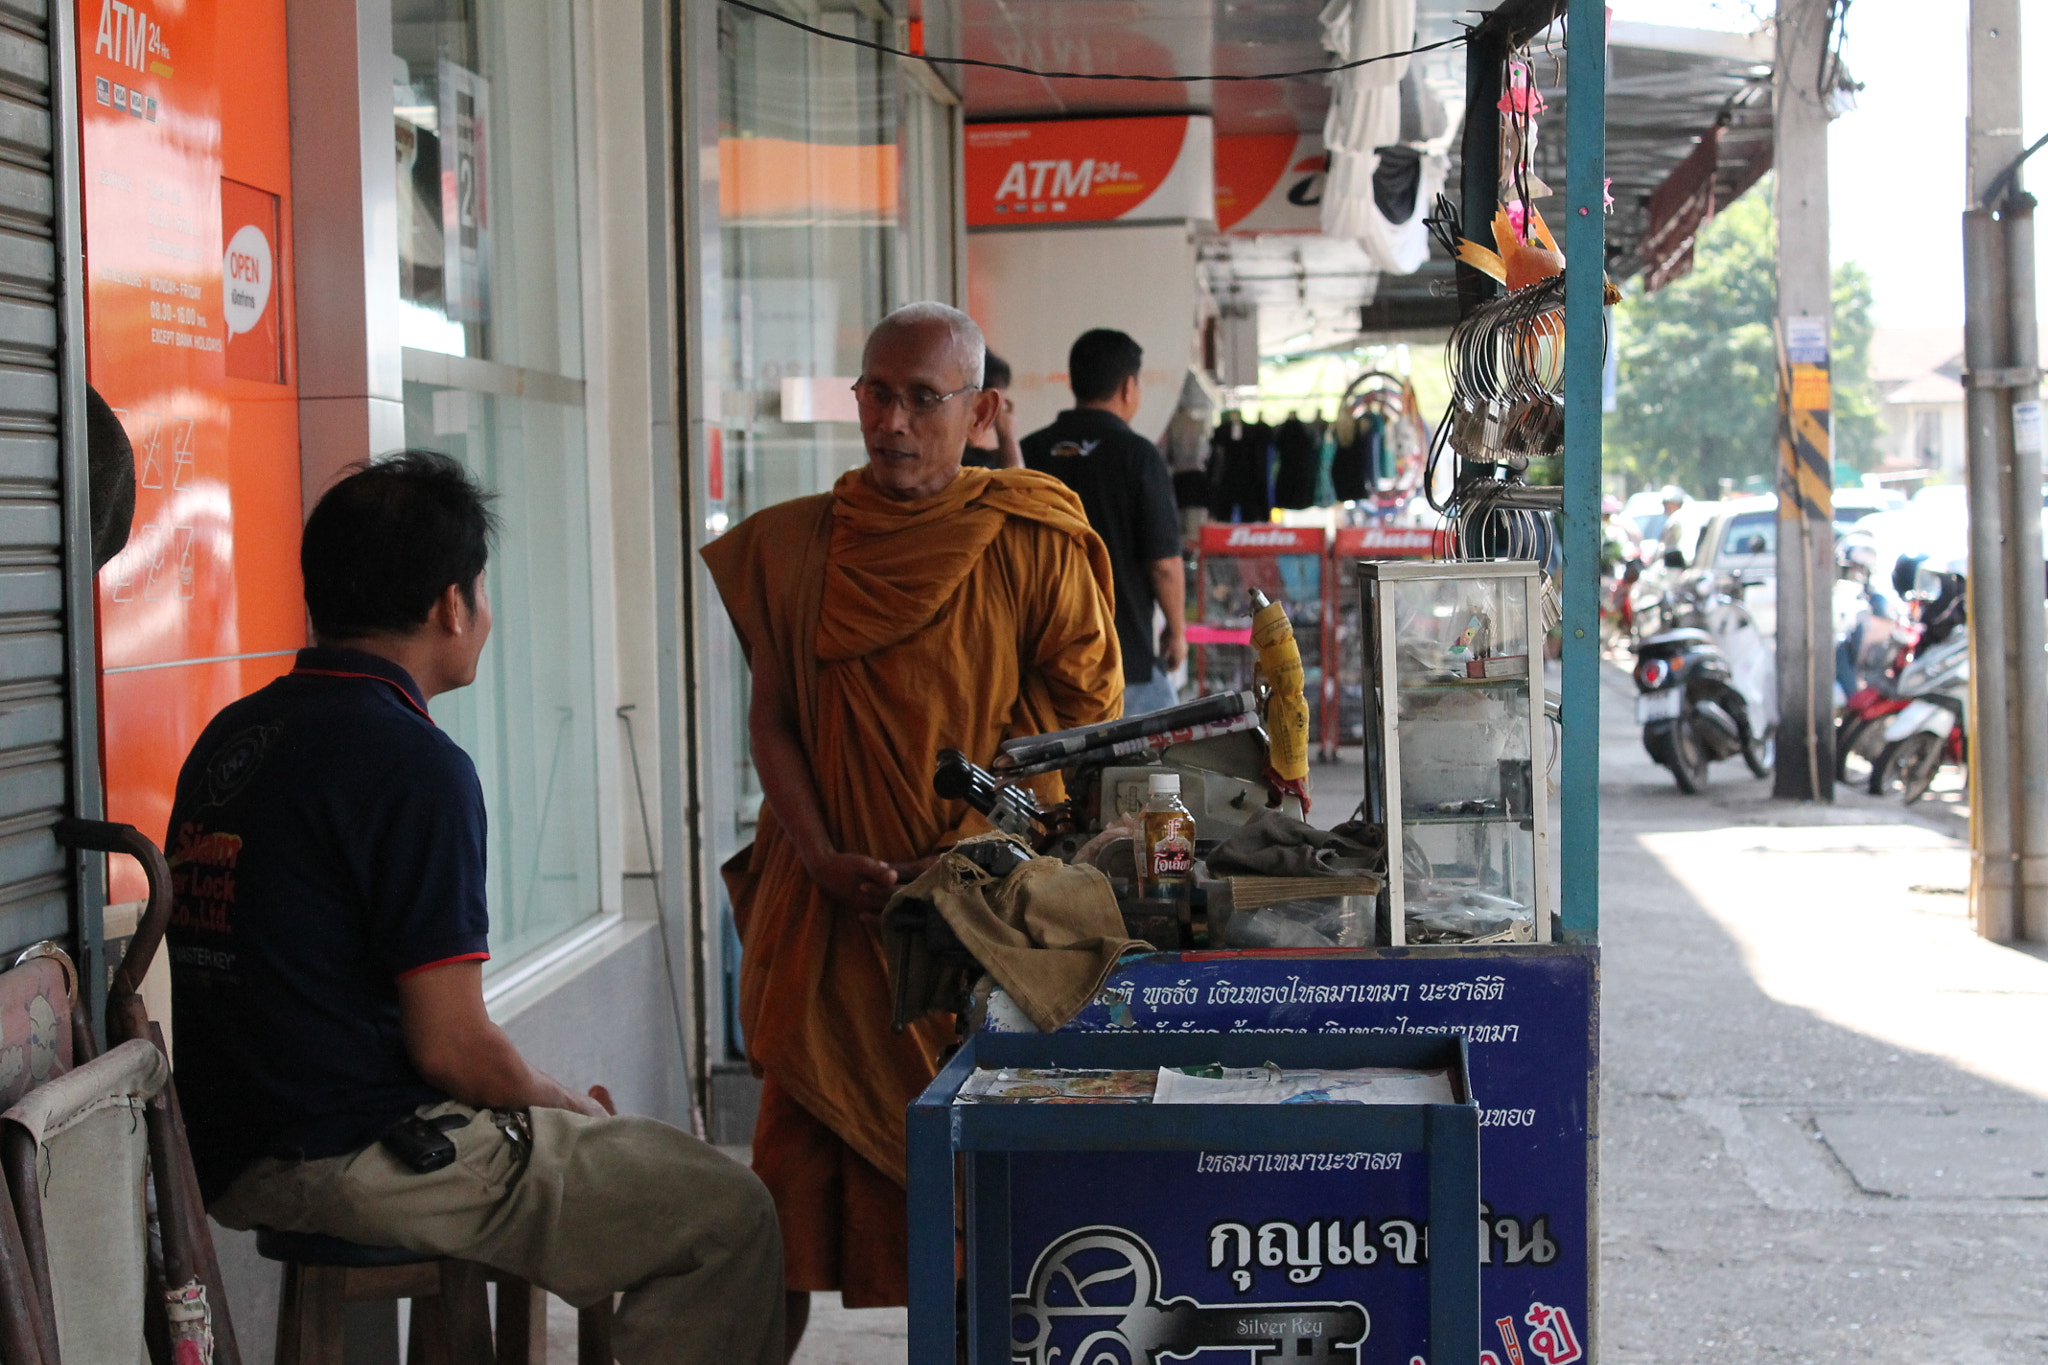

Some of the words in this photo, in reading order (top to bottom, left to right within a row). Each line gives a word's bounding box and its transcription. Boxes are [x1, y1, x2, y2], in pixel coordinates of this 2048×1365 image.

[95, 0, 147, 72] ATM
[148, 22, 161, 55] 24
[994, 158, 1096, 200] ATM
[1095, 161, 1121, 183] 24
[231, 252, 259, 284] OPEN
[177, 821, 240, 868] Siam
[191, 866, 237, 903] Lock
[1206, 975, 1410, 1005] เงินทองไหลมาเทมา
[1419, 975, 1506, 1001] นะชาลีติ
[1236, 1317, 1287, 1337] Silver
[1291, 1317, 1323, 1337] Key
